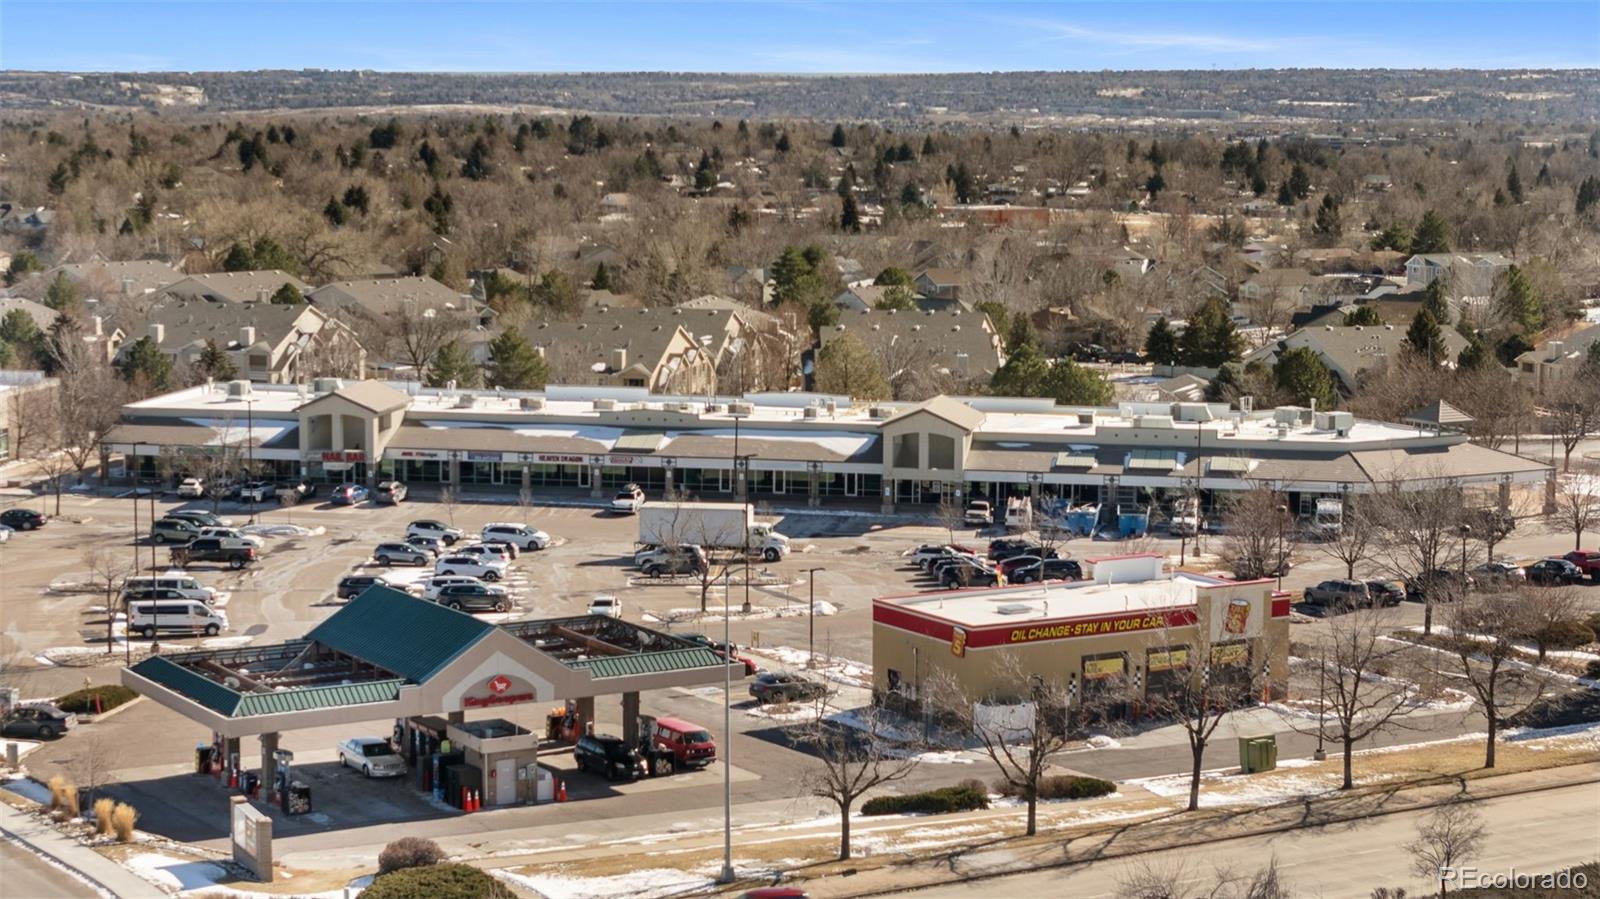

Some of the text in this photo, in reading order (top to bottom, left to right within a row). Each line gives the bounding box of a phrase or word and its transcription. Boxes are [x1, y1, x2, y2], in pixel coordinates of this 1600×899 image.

[321, 451, 368, 462] NAIL BAR
[1011, 616, 1164, 641] OIL CHANGE STAY IN YOUR CAR
